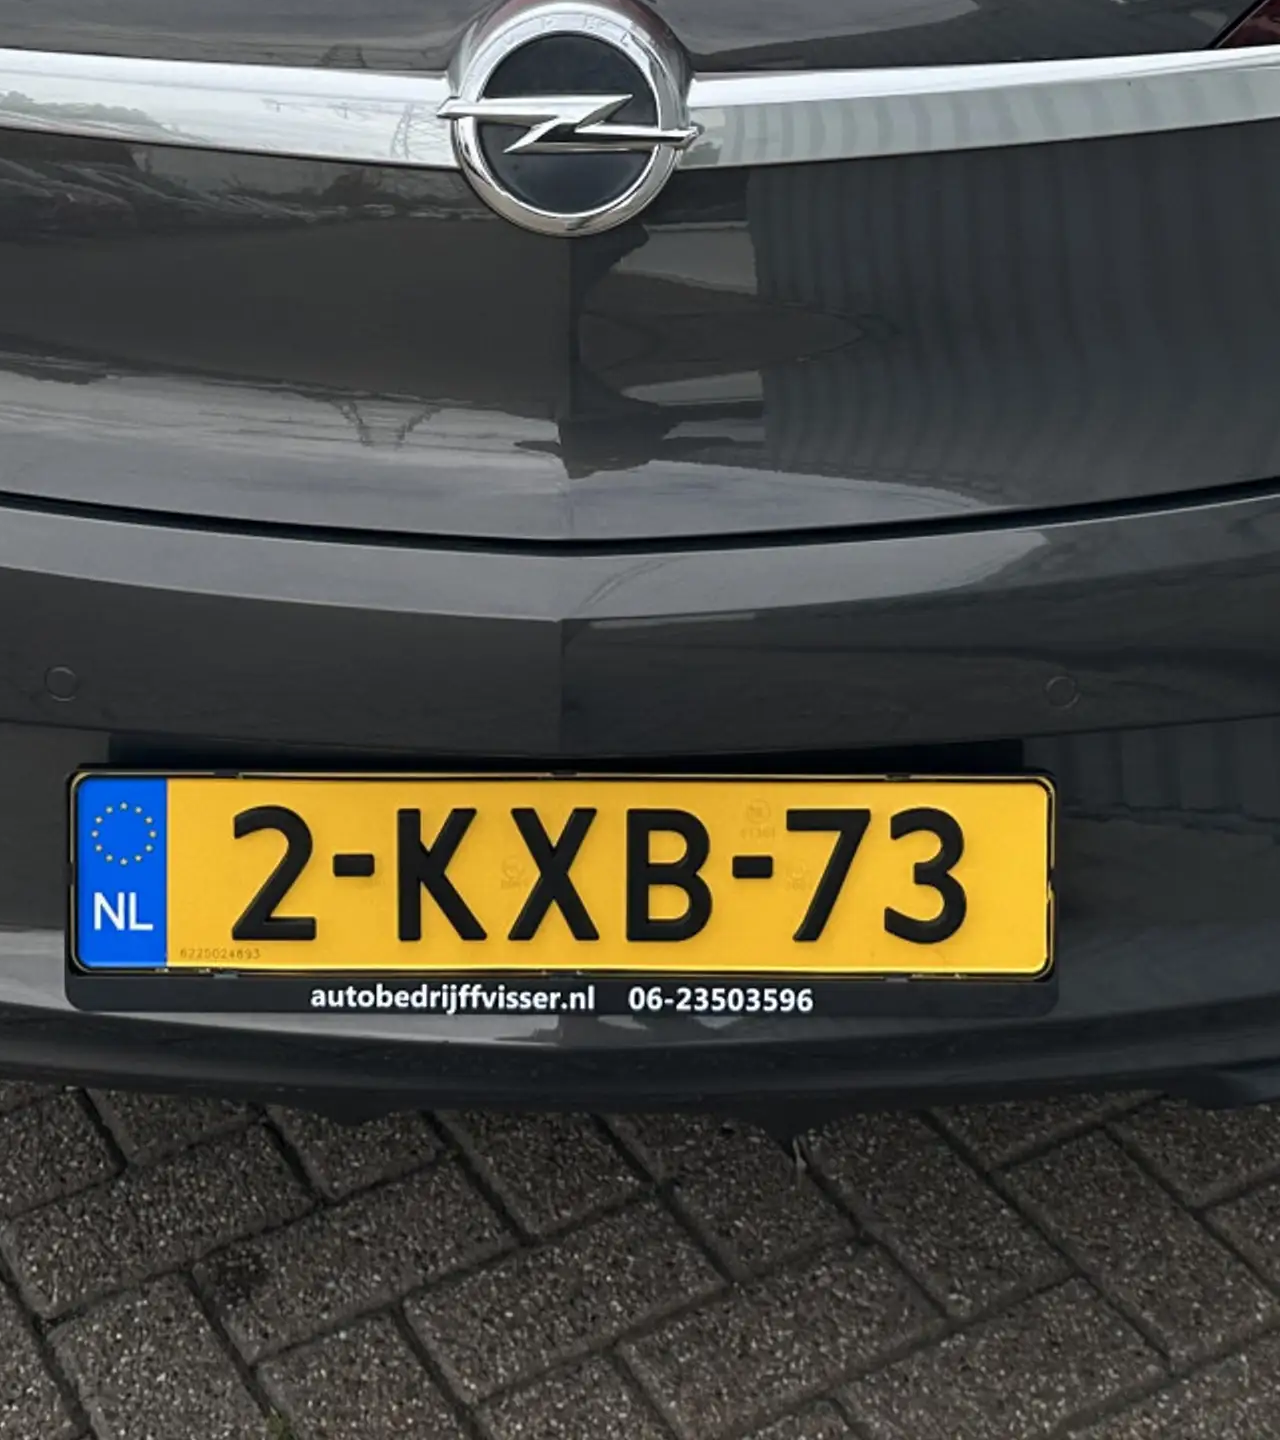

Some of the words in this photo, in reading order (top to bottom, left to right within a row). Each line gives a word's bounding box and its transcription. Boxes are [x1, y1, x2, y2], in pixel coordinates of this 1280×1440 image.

[230, 804, 970, 946] 2-KXB-73
[93, 891, 155, 932] NL
[310, 983, 596, 1015] autobedrijffvisser.nl
[628, 986, 814, 1013] 06-23503596
